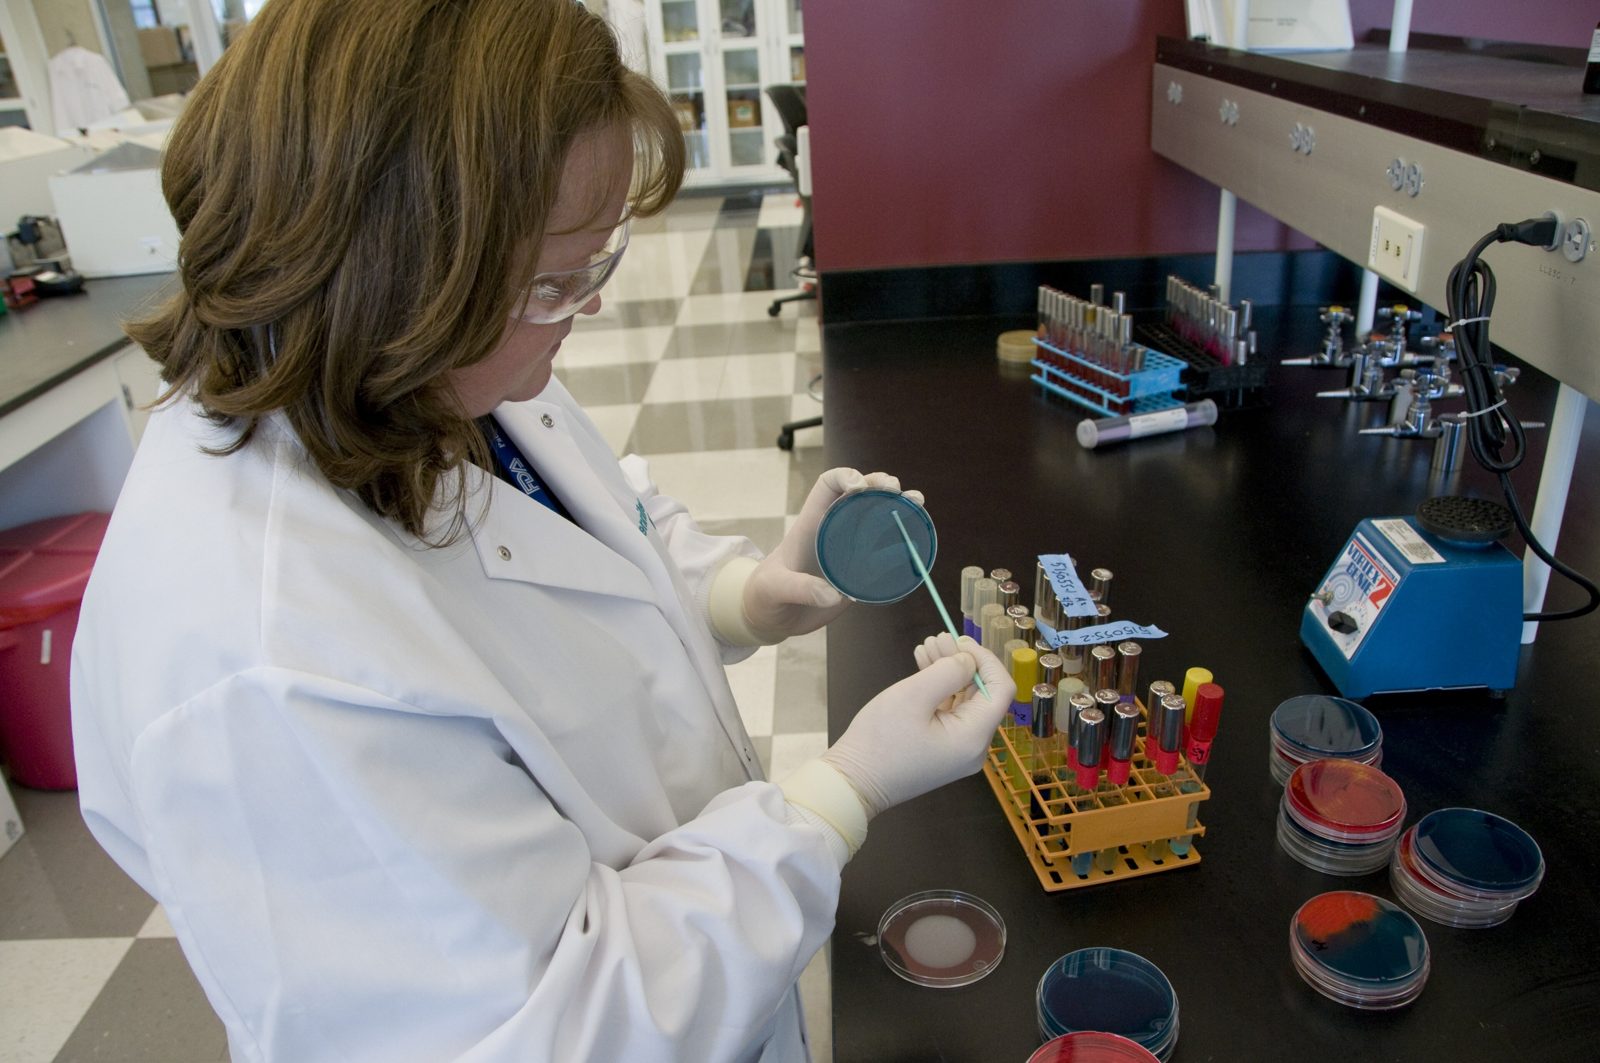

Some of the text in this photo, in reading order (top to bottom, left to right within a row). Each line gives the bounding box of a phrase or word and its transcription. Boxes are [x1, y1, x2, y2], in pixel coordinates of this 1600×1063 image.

[509, 456, 541, 495] FDA
[1347, 542, 1380, 584] VORTEX
[1345, 562, 1373, 597] GENIE
[1368, 577, 1394, 610] 2
